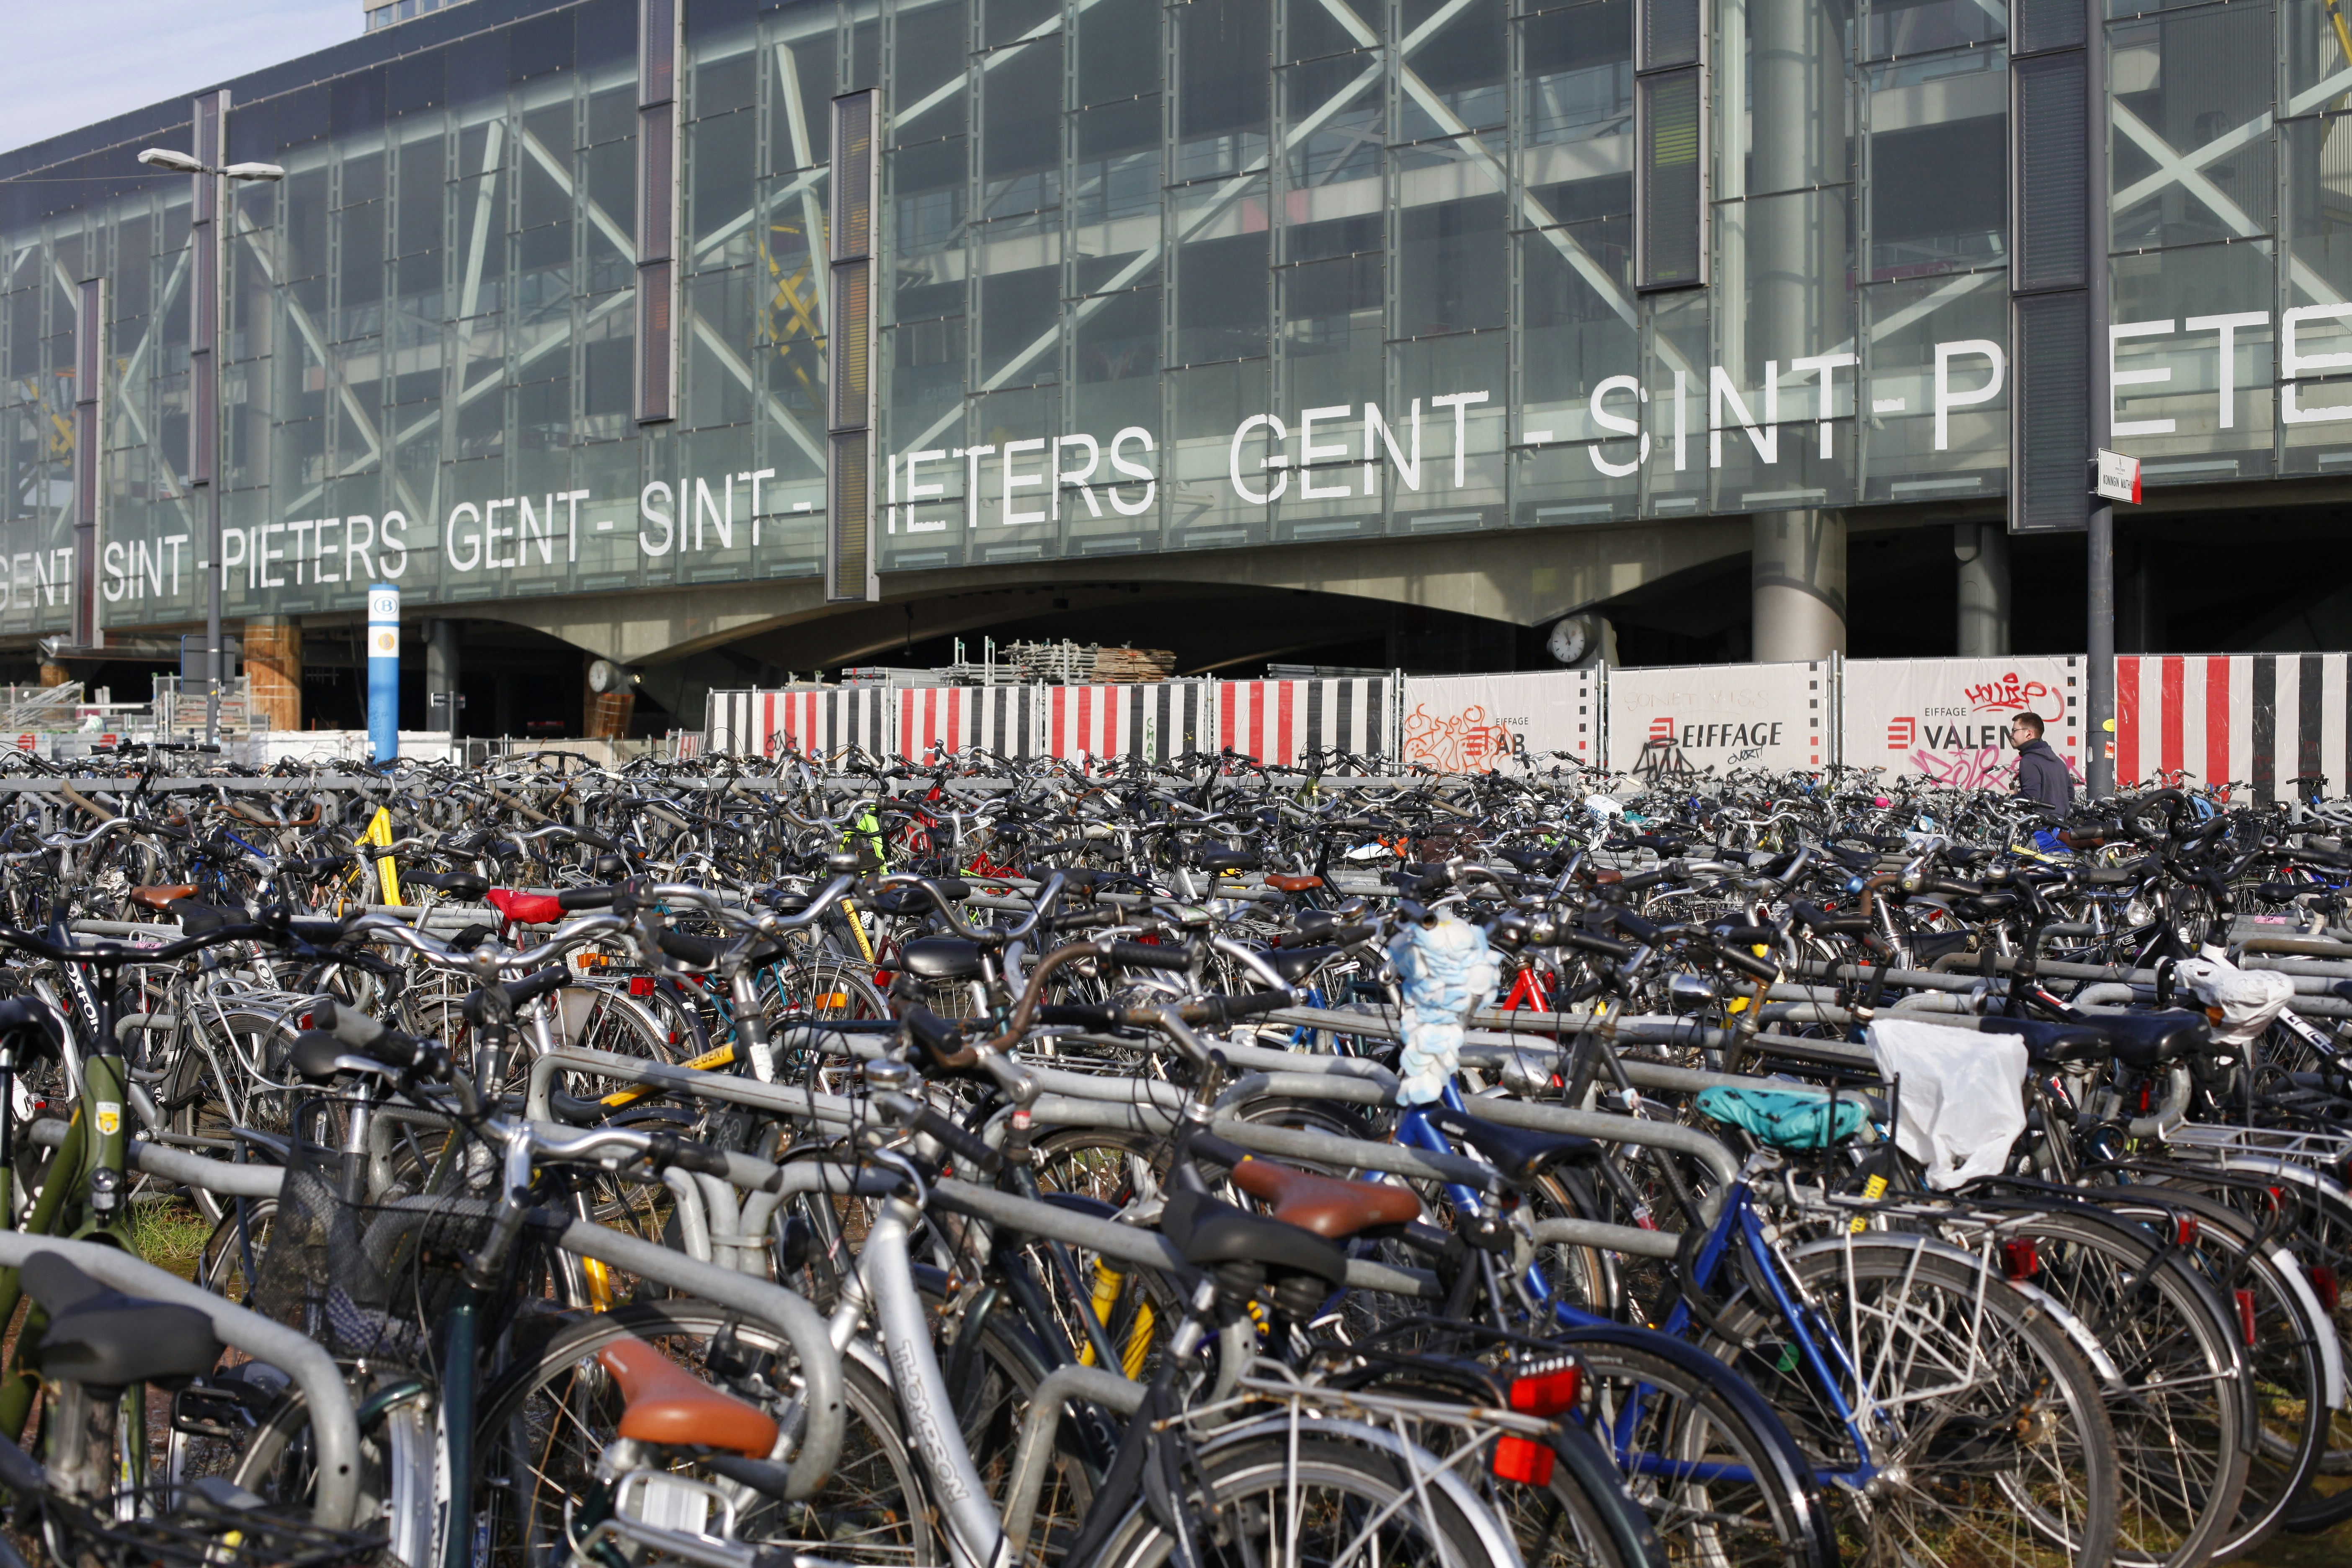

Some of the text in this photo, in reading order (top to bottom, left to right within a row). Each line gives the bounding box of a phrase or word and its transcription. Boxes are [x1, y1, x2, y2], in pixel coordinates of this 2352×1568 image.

[2103, 474, 2119, 488] KONINGIN
[1924, 707, 1967, 717] EIFFAGE
[1496, 717, 1529, 726] EIFFAGE
[1682, 722, 1783, 748] EIFFAGE
[1496, 733, 1525, 755] AB
